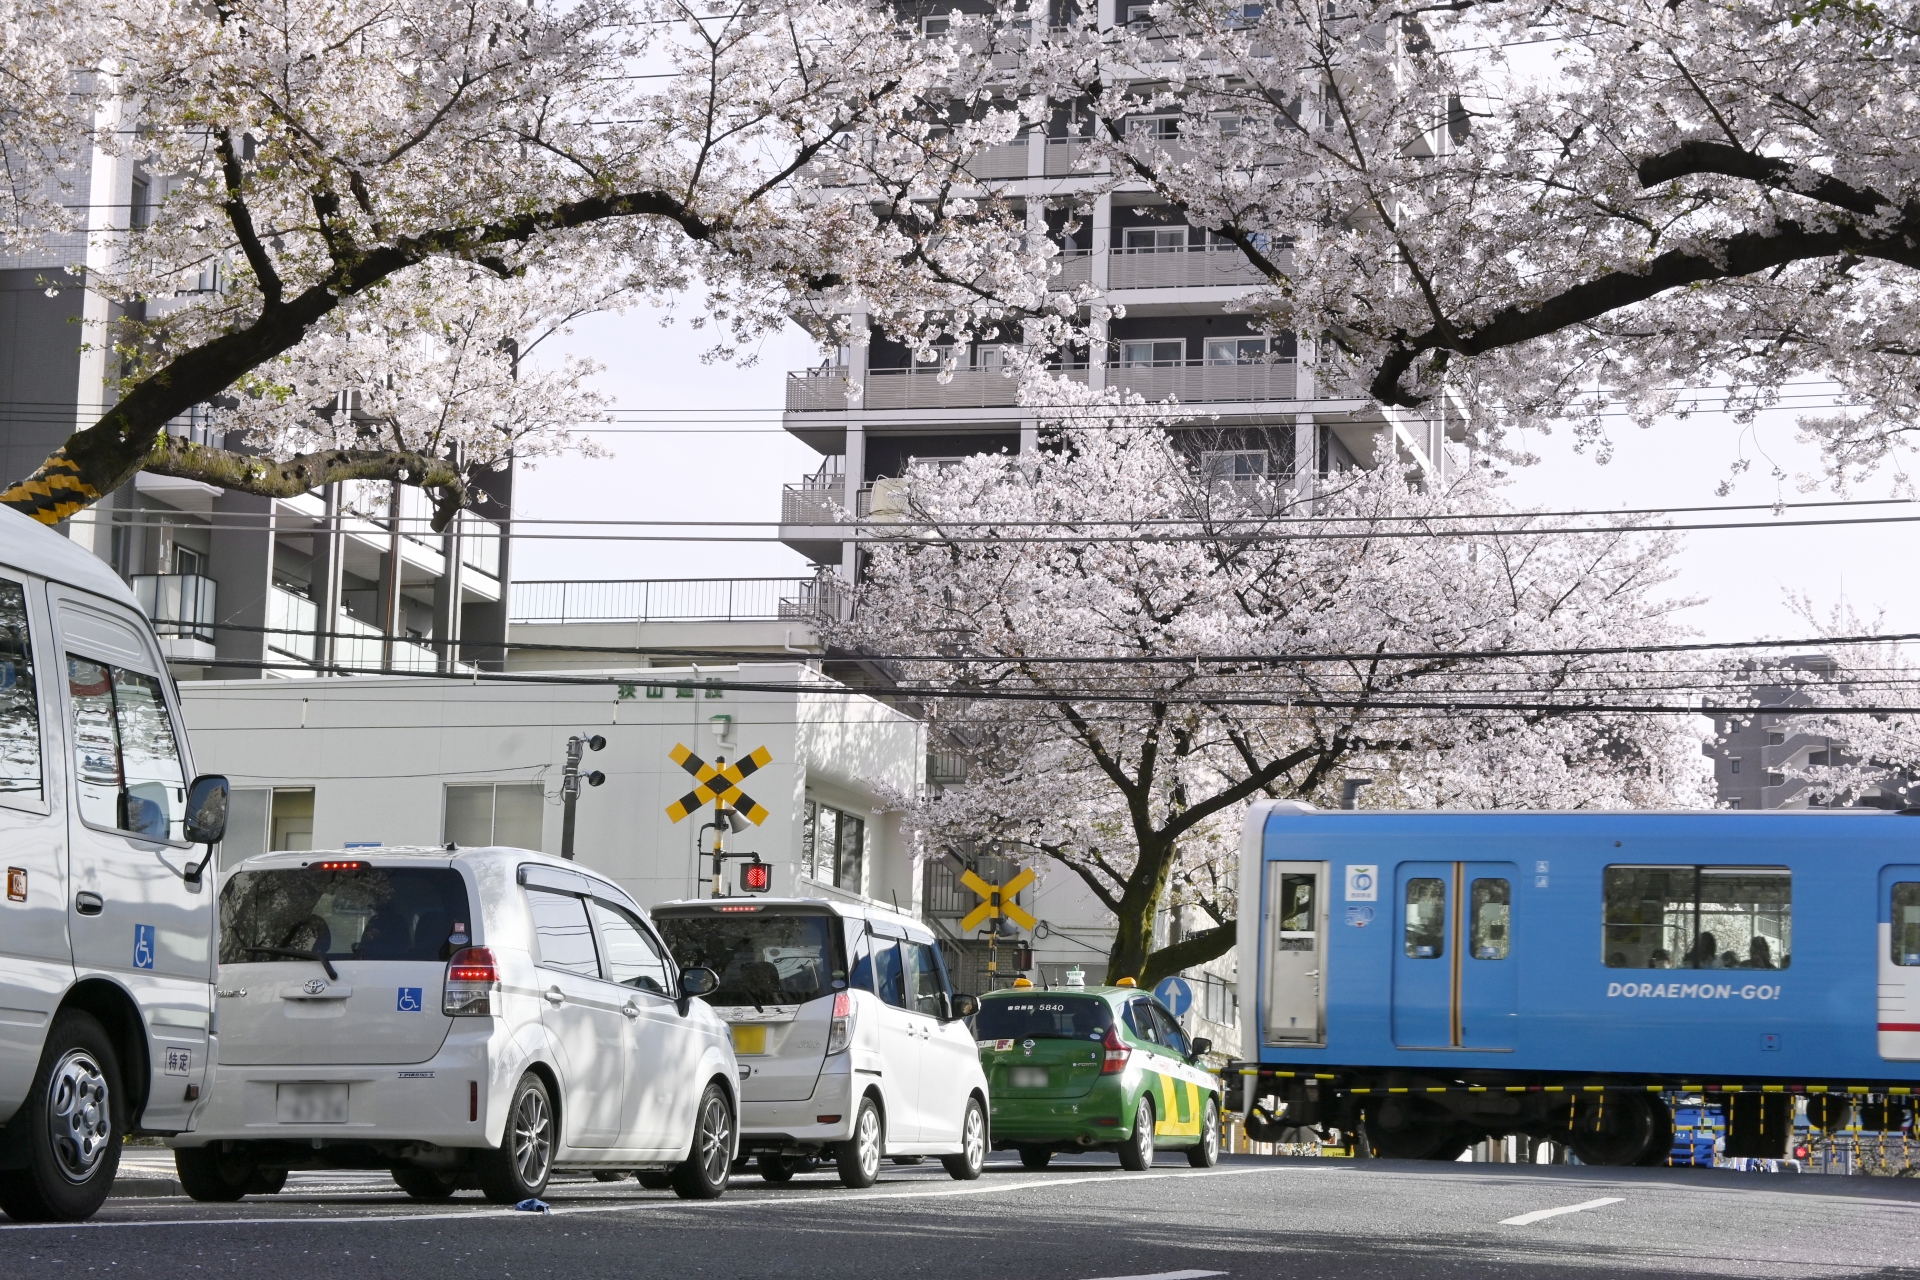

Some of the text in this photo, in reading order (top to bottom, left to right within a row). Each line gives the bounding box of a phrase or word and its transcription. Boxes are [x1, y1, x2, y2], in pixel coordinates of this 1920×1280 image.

[1607, 982, 1781, 1000] DORAEMON-GO!
[1038, 1004, 1064, 1012] 5840
[168, 1052, 188, 1071] 特定
